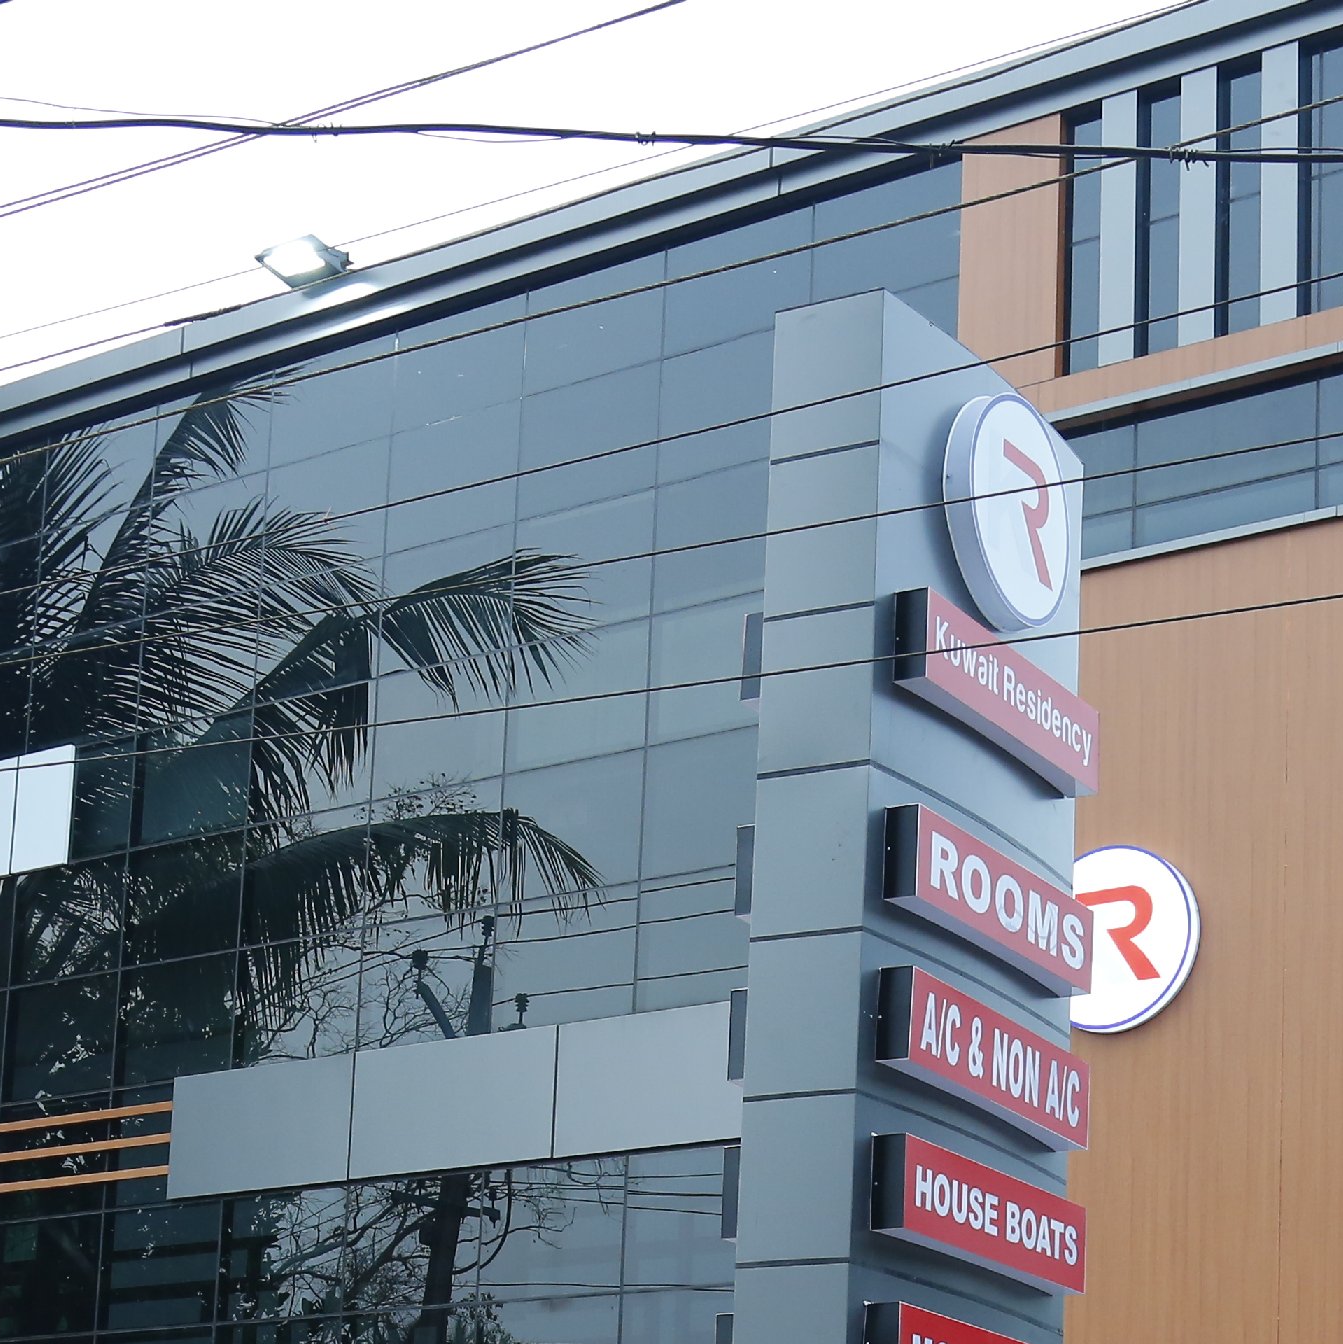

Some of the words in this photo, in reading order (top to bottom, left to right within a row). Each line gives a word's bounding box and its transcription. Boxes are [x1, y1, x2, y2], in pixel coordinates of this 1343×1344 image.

[935, 615, 999, 696] Kuwait
[1003, 665, 1092, 767] Residency
[929, 830, 1086, 971] ROOMS
[920, 992, 962, 1067] A/C
[968, 1016, 985, 1079] &
[991, 1028, 1041, 1108] NON
[1044, 1059, 1081, 1128] A/C
[914, 1164, 999, 1237] HOUSE
[1006, 1201, 1078, 1266] BOATS
